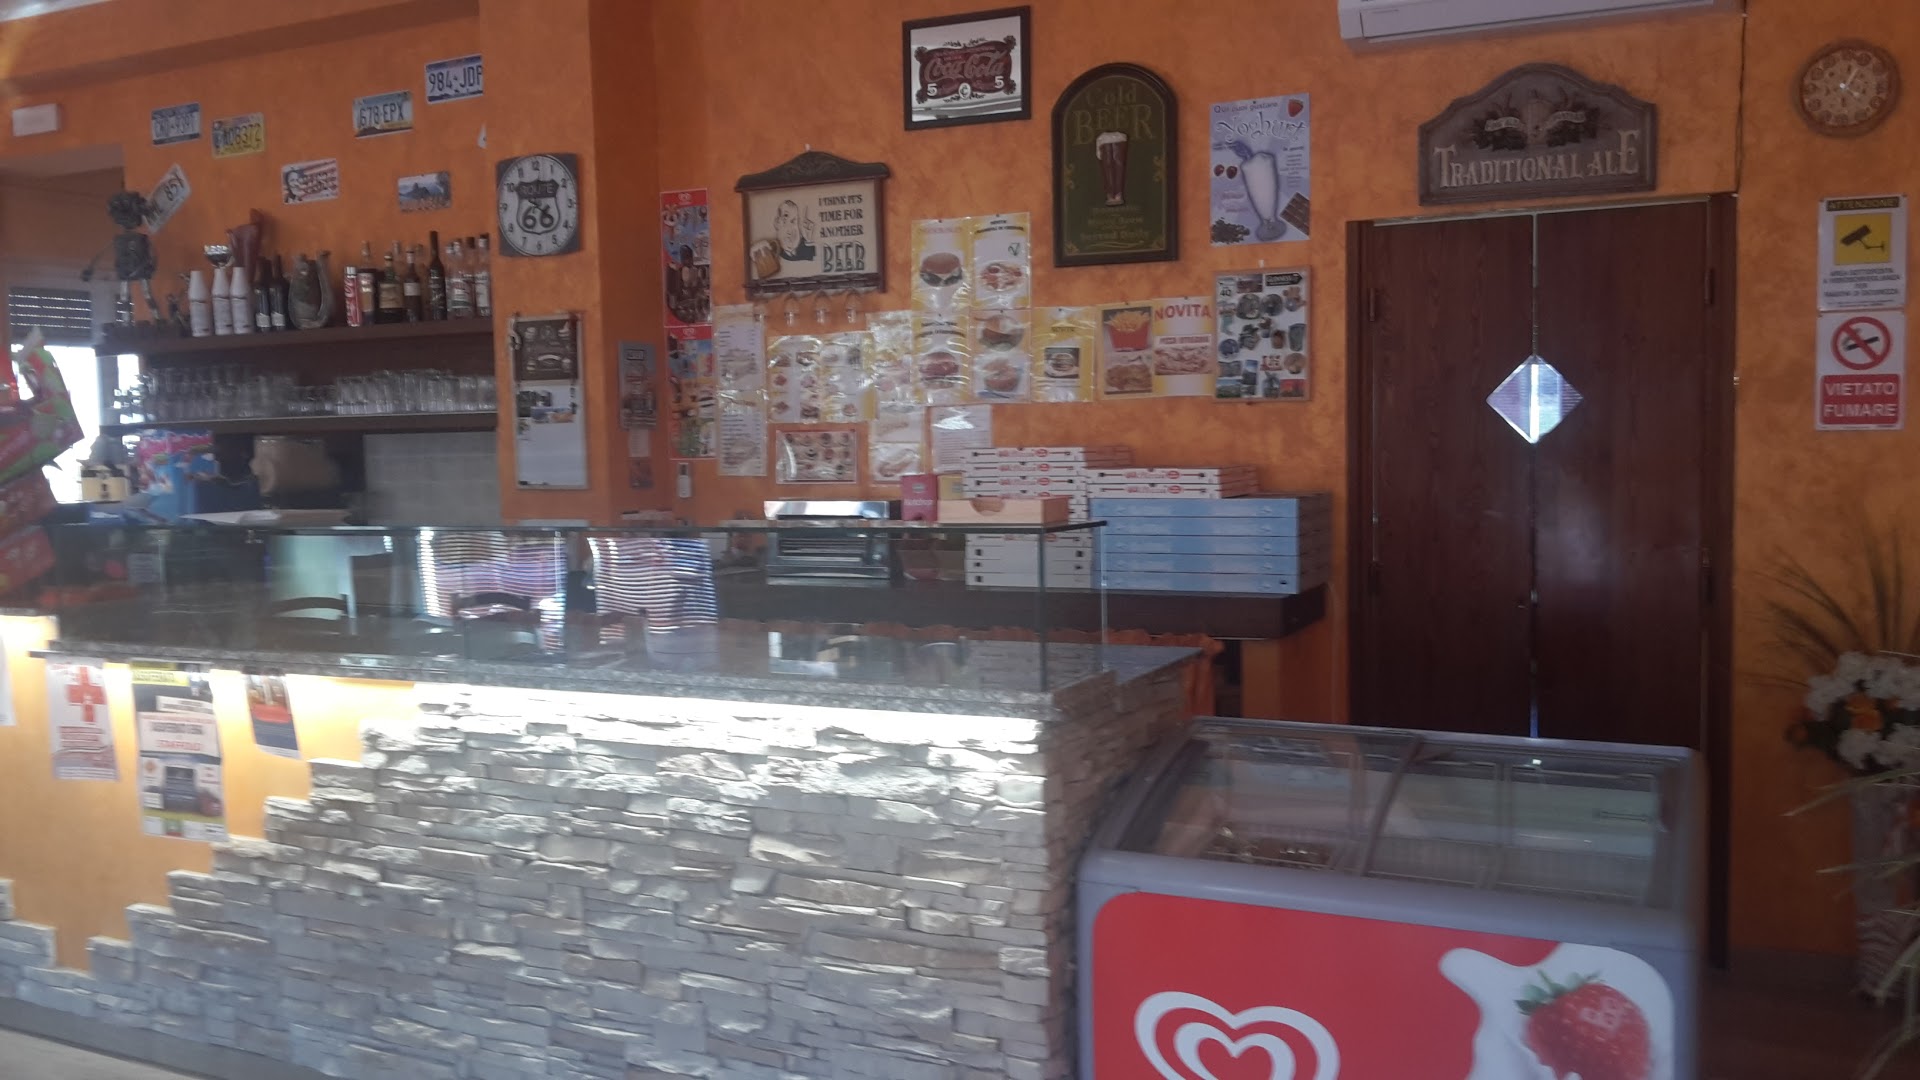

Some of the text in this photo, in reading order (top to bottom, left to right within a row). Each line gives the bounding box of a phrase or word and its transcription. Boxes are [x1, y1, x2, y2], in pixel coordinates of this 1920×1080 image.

[994, 76, 1004, 88] 5
[927, 83, 938, 96] 5
[1072, 104, 1157, 145] BEER
[1433, 129, 1640, 188] TRADITIONAL ALE
[523, 205, 554, 229] 66
[820, 208, 863, 222] TIME FOR
[820, 224, 864, 238] ANOTHER
[823, 241, 865, 273] BEER
[1825, 382, 1897, 396] VIETATO
[1824, 403, 1897, 417] FUMARE
